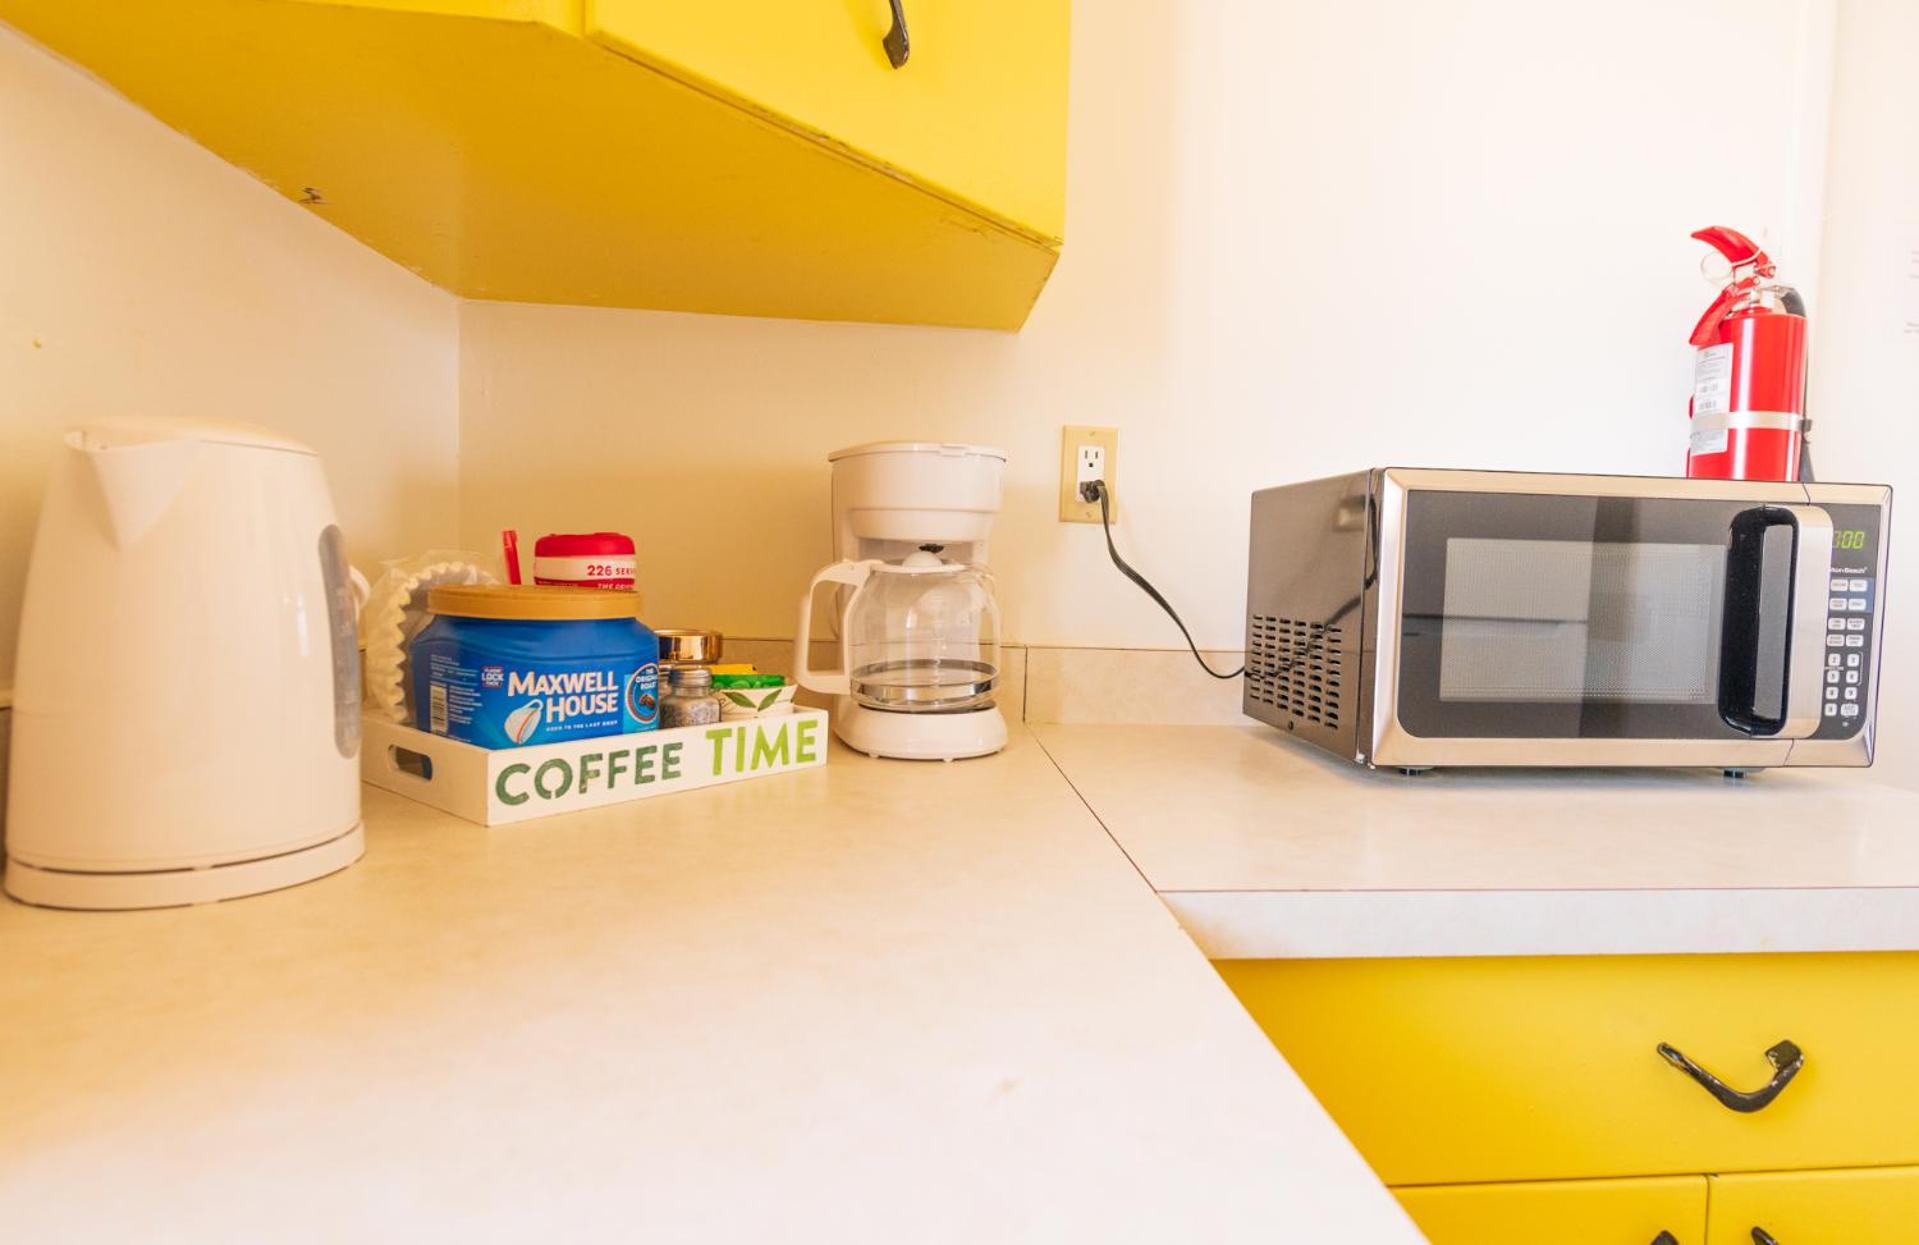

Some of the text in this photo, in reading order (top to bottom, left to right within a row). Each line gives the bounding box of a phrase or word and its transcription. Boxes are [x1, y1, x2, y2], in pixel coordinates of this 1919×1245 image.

[587, 565, 613, 577] 226
[507, 671, 620, 697] MAXWELL
[545, 692, 619, 723] HOUSE
[494, 718, 819, 807] COFFEE TIME
